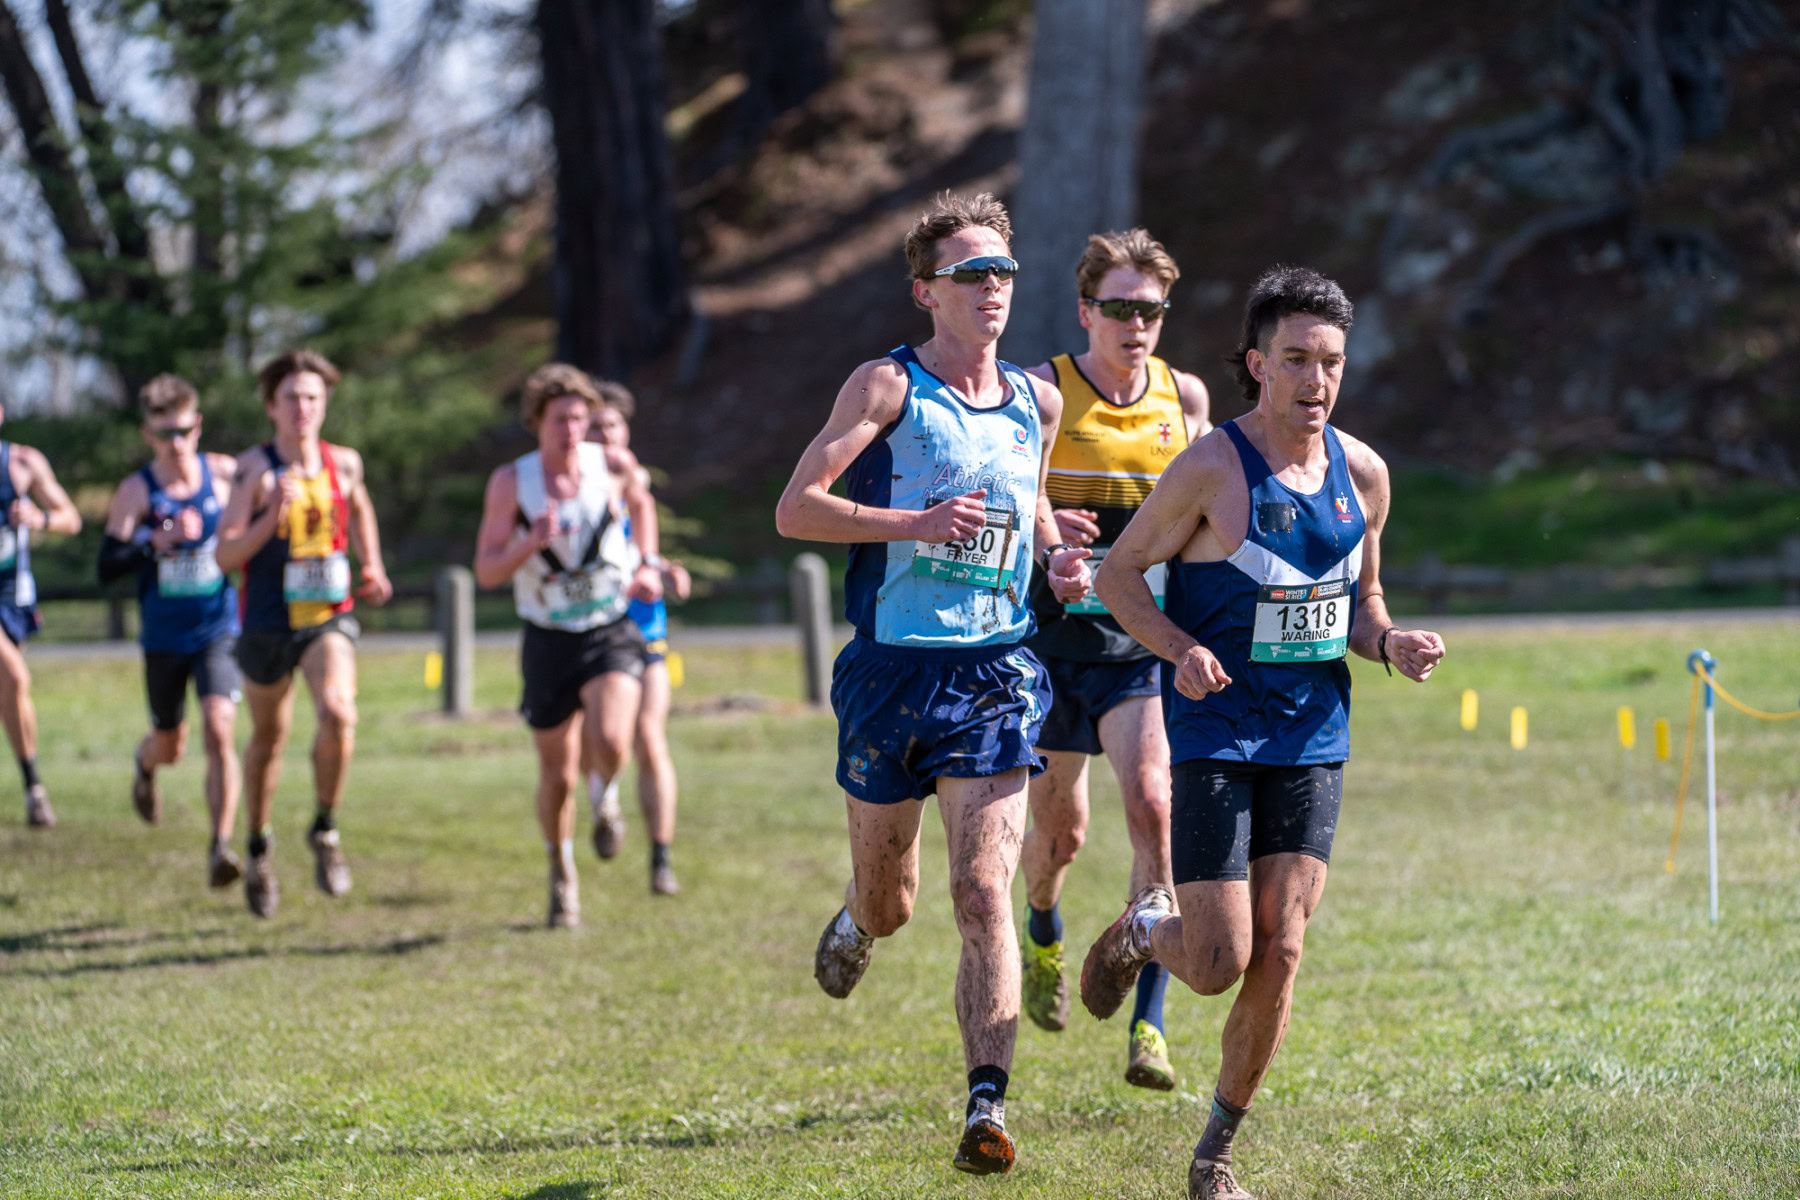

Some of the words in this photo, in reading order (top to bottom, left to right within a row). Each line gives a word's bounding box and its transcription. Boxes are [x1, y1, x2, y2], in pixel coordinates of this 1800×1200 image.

[932, 462, 1022, 496] Athletics
[944, 528, 995, 554] 30
[946, 549, 988, 565] FRYER
[1276, 601, 1337, 631] 1318
[1281, 629, 1331, 643] WARING
